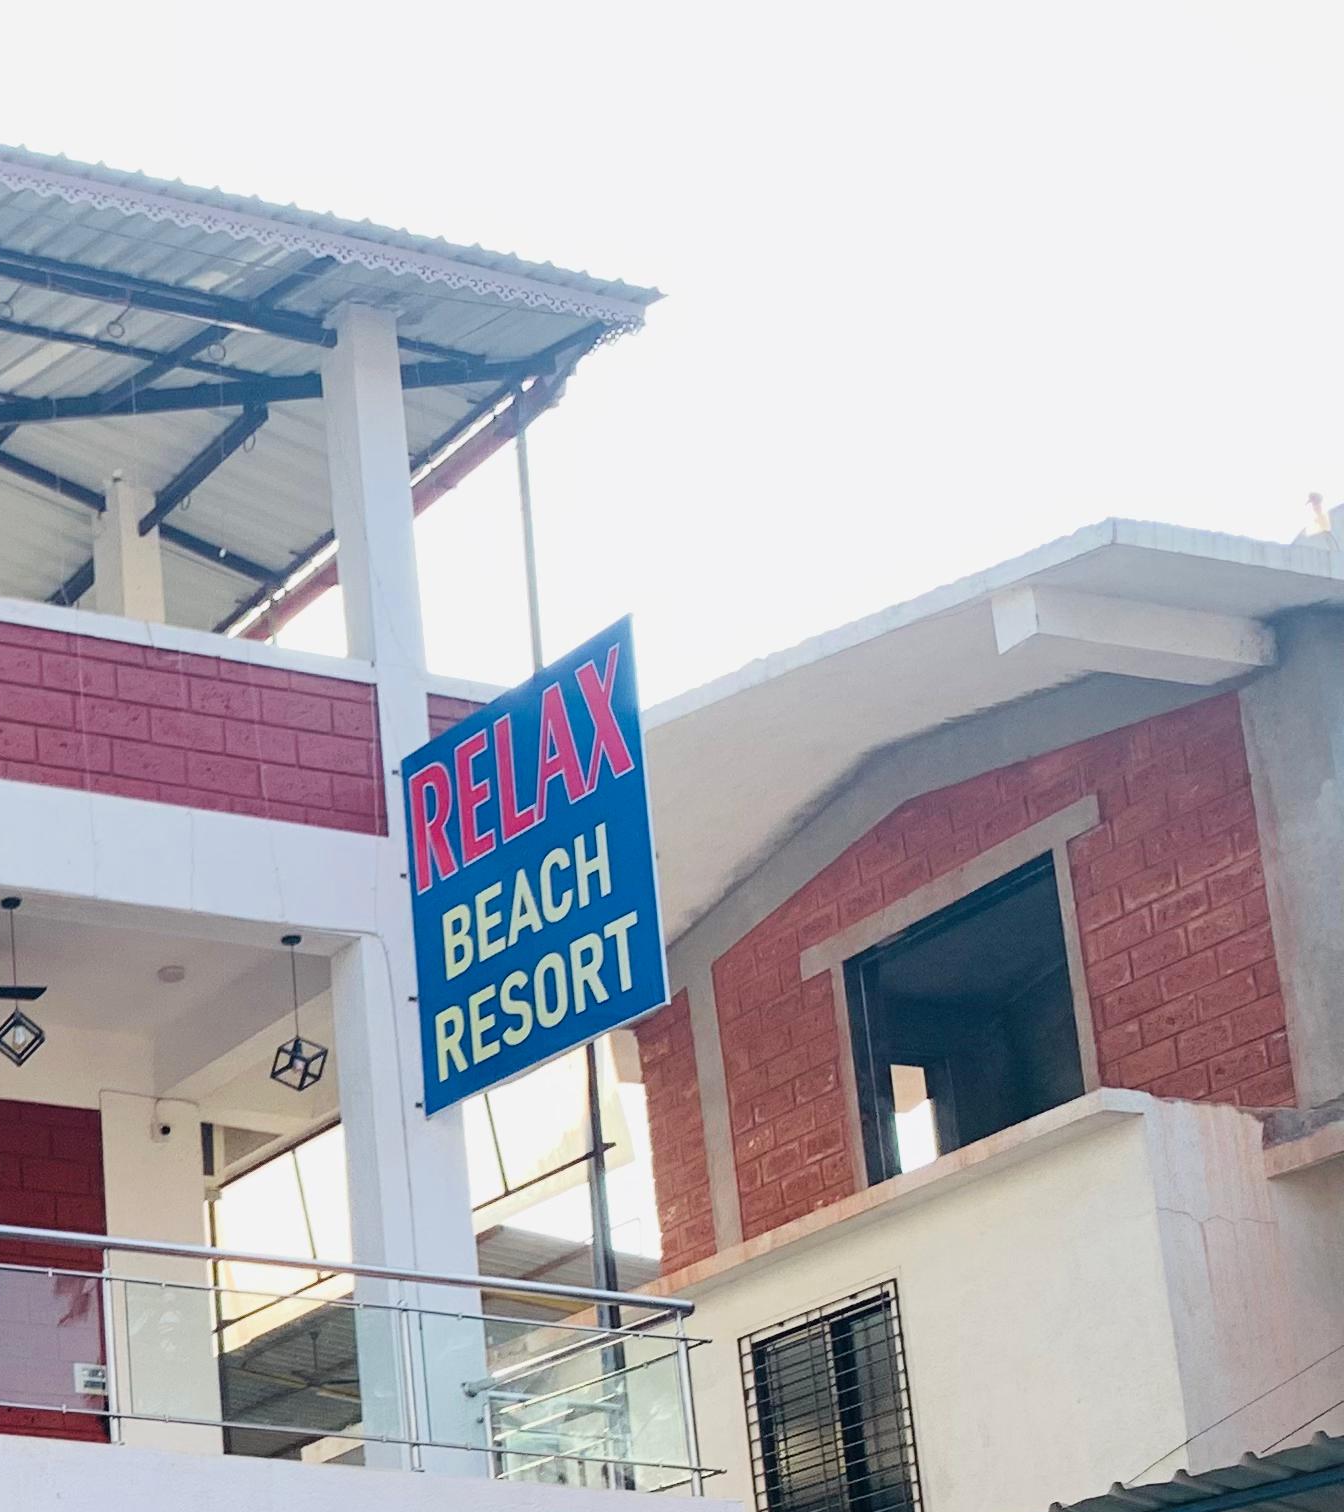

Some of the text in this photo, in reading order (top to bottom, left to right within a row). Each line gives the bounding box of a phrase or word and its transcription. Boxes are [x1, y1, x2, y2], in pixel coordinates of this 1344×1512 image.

[408, 642, 635, 895] RELAX
[441, 822, 612, 981] BEACH
[433, 910, 639, 1083] RESORT
